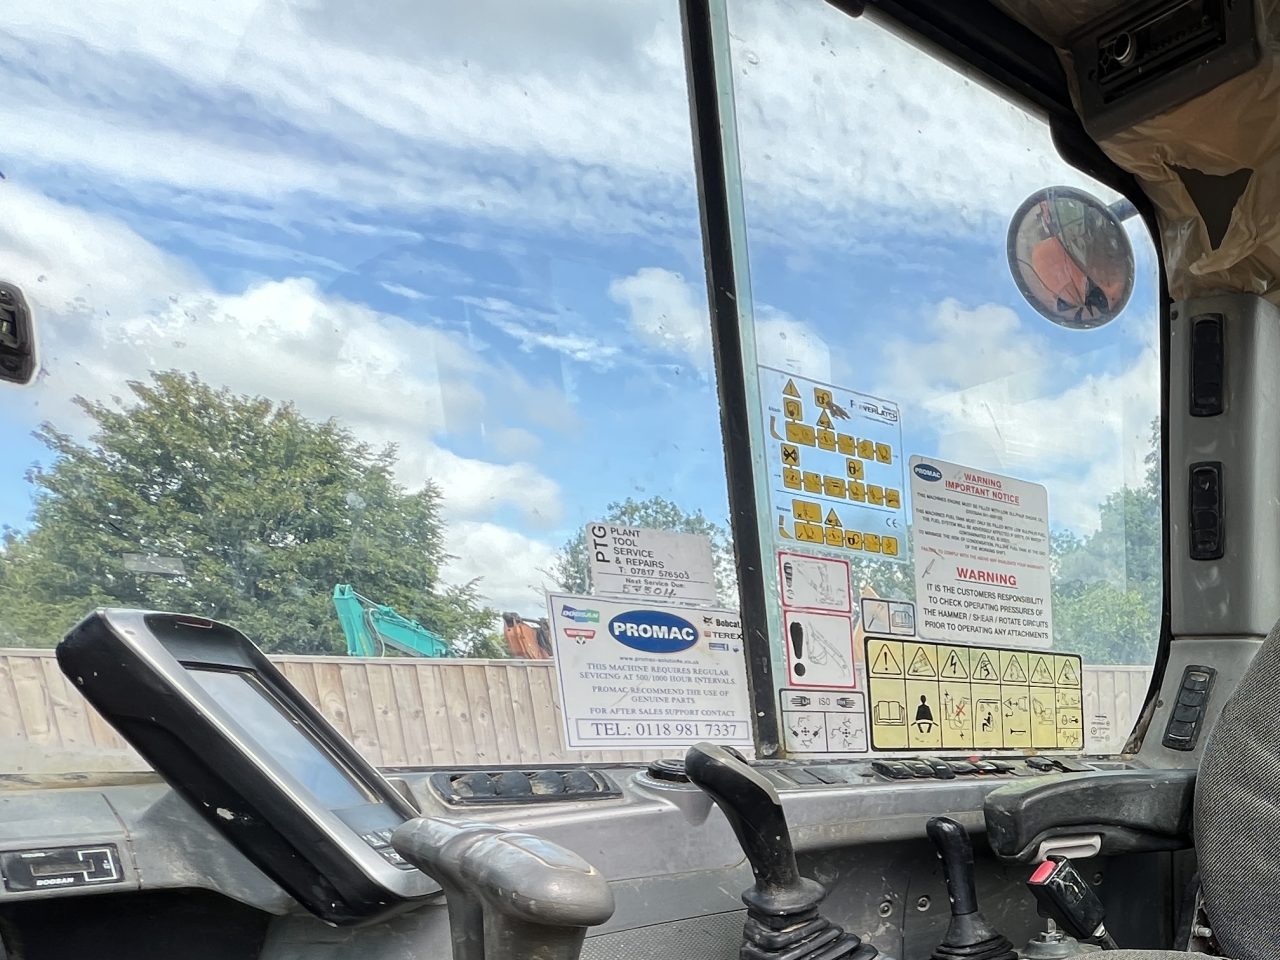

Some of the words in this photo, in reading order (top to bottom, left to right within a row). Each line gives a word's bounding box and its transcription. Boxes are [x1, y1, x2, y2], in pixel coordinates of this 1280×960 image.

[915, 467, 941, 478] PROMAC
[964, 472, 1002, 488] WARNING
[945, 480, 989, 497] IMPORTANT
[992, 491, 1019, 504] NOTICE
[610, 528, 640, 538] PLANT
[592, 525, 610, 563] PTG
[612, 537, 638, 547] TOOL
[614, 547, 654, 558] SERVICE
[626, 558, 664, 568] REPAIRS
[630, 568, 655, 576] 07817
[956, 568, 1017, 585] WARNING
[644, 579, 669, 587] Service
[935, 584, 941, 592] IS
[943, 585, 955, 594] THE
[957, 588, 996, 600] CUSTOMERS
[998, 593, 1043, 605] RESPONSIBILITY
[928, 596, 938, 604] TO
[940, 597, 962, 607] CHECK
[964, 600, 998, 612] OPERATING
[1001, 605, 1035, 615] PRESSURES
[924, 608, 936, 616] THE
[938, 610, 967, 620] HAMMER
[973, 614, 993, 623] SHEAR
[999, 617, 1021, 626] ROTATE
[1023, 619, 1048, 628] CIRCUITS
[613, 622, 695, 641] PROMAC
[712, 632, 743, 640] TEREX
[925, 621, 945, 629] PRIOR
[947, 623, 955, 631] TO
[958, 624, 992, 635] OPERATING
[994, 628, 1006, 636] ANY
[1008, 630, 1048, 639] ATTACHMENTS
[580, 672, 620, 680] SEVICING
[588, 662, 607, 670] THIS
[609, 664, 648, 672] MACHINE
[652, 666, 690, 674] REQUIRES
[693, 668, 730, 676] REGULAR
[592, 686, 628, 694] PROMAC
[630, 687, 684, 695] RECOMMEND
[591, 722, 631, 736] TEL:
[636, 723, 671, 736] 0118
[676, 724, 699, 736] 981
[704, 724, 736, 736] 7337
